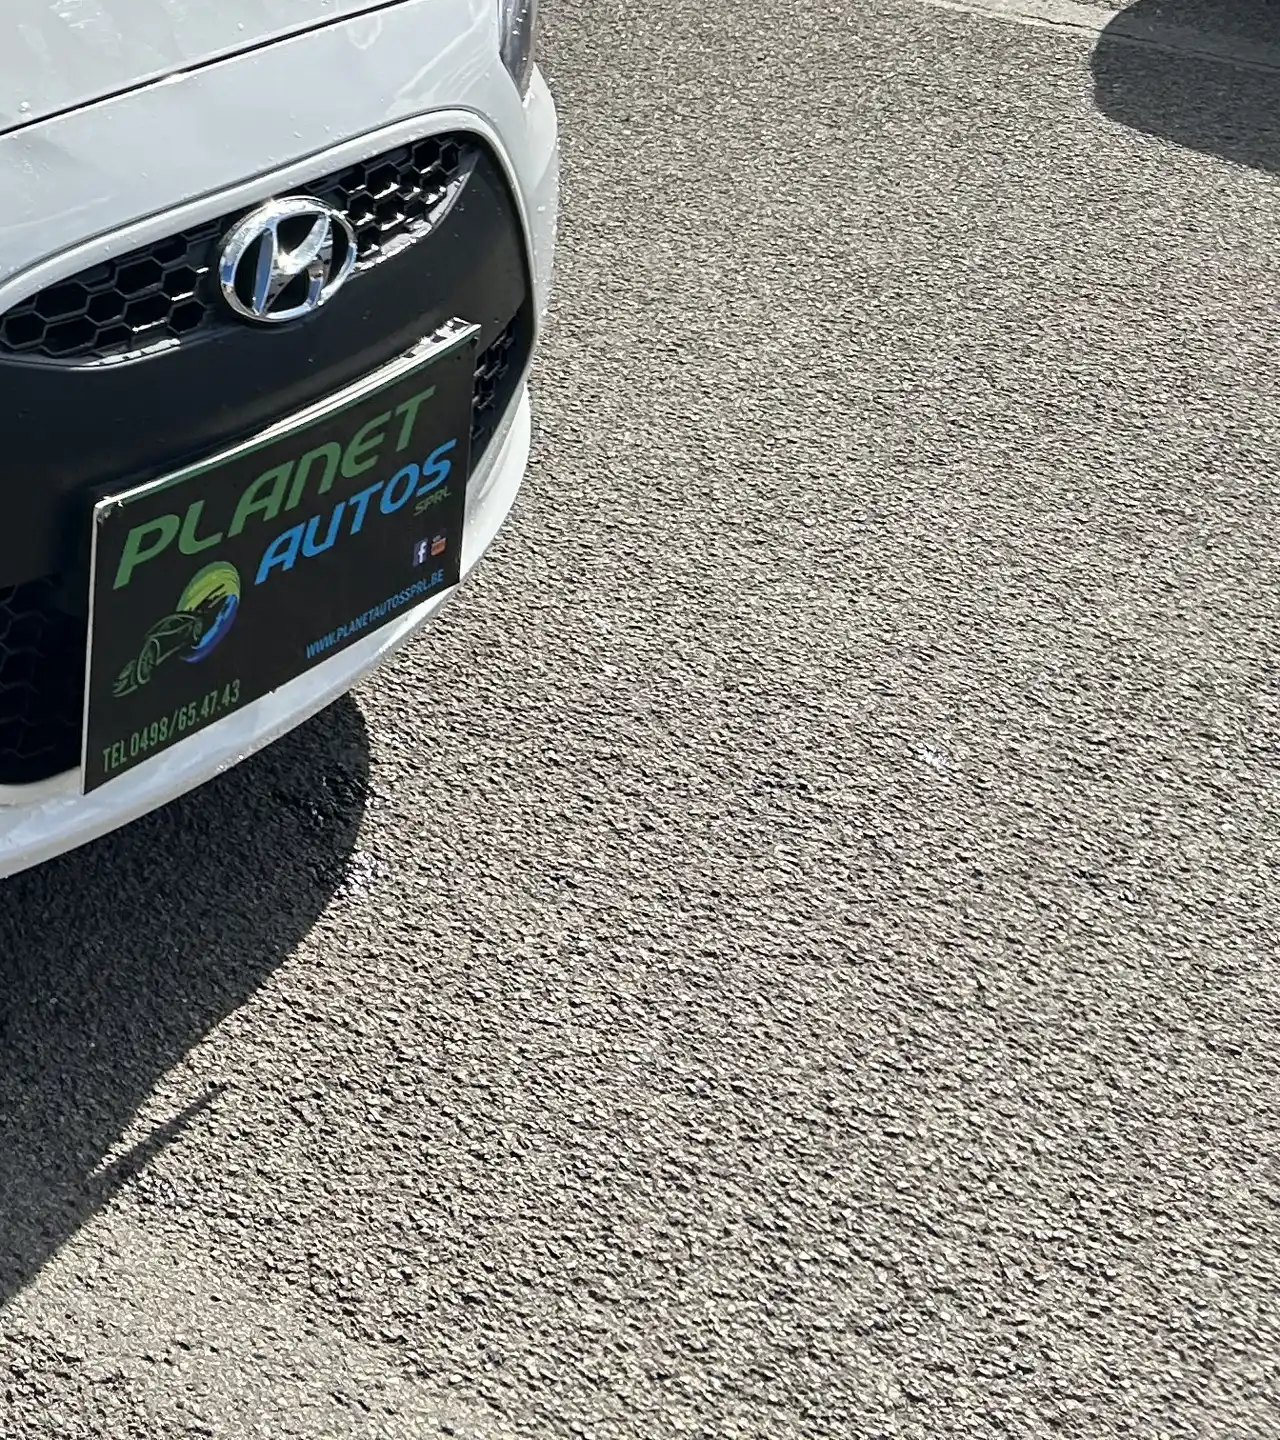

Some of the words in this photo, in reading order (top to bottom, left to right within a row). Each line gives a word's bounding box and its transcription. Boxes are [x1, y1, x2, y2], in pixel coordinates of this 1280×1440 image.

[112, 385, 437, 590] PLANET
[253, 437, 458, 586] AUTOS
[305, 568, 445, 660] WWW.PLANETAUTOSSPRL.BE
[102, 739, 128, 774] TEL
[130, 678, 241, 758] 0498/65.47.43
